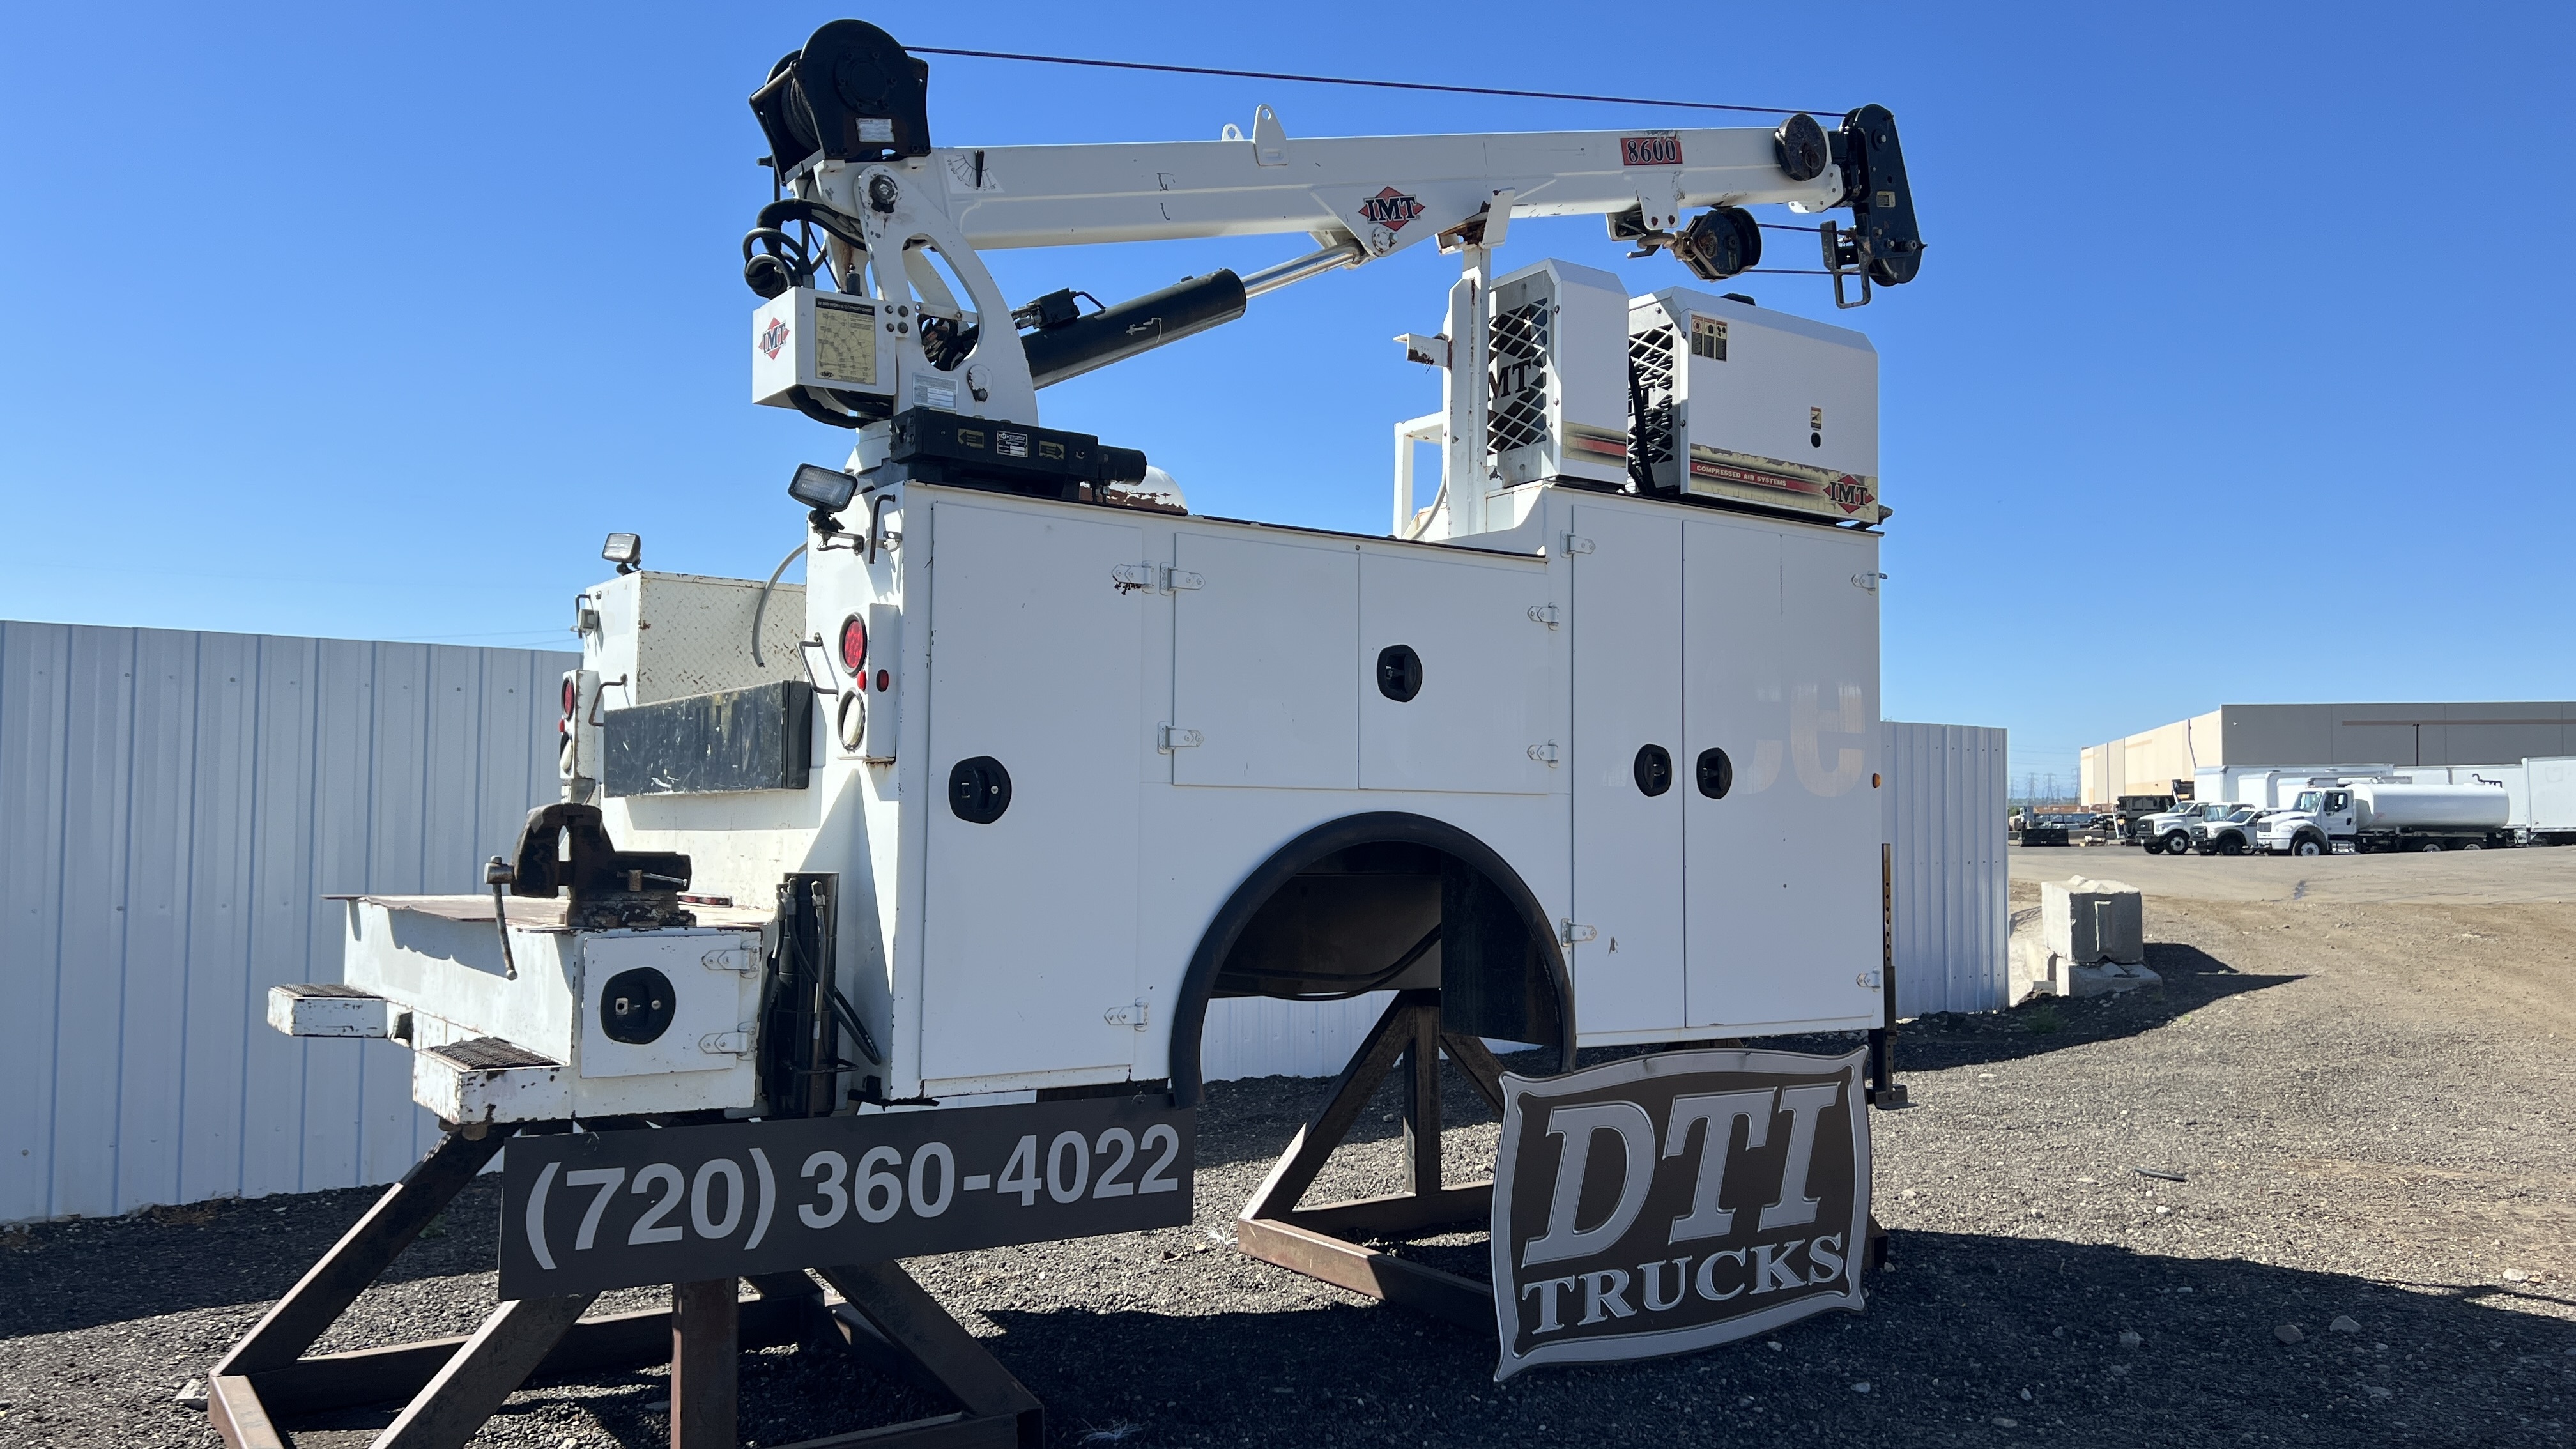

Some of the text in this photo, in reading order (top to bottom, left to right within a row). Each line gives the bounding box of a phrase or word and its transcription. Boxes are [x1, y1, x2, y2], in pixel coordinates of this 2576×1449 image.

[1627, 140, 1676, 163] 8600
[1365, 196, 1416, 222] IMT
[762, 321, 786, 355] IMT
[1488, 358, 1531, 401] MT
[1696, 465, 1741, 478] COMPRESSED
[1757, 476, 1787, 487] SYSTEMS
[1830, 481, 1868, 506] IMT
[1521, 1081, 1841, 1268] DTI
[526, 1123, 1180, 1270] (720) 360-4022
[1522, 1232, 1844, 1335] TRUCKS
